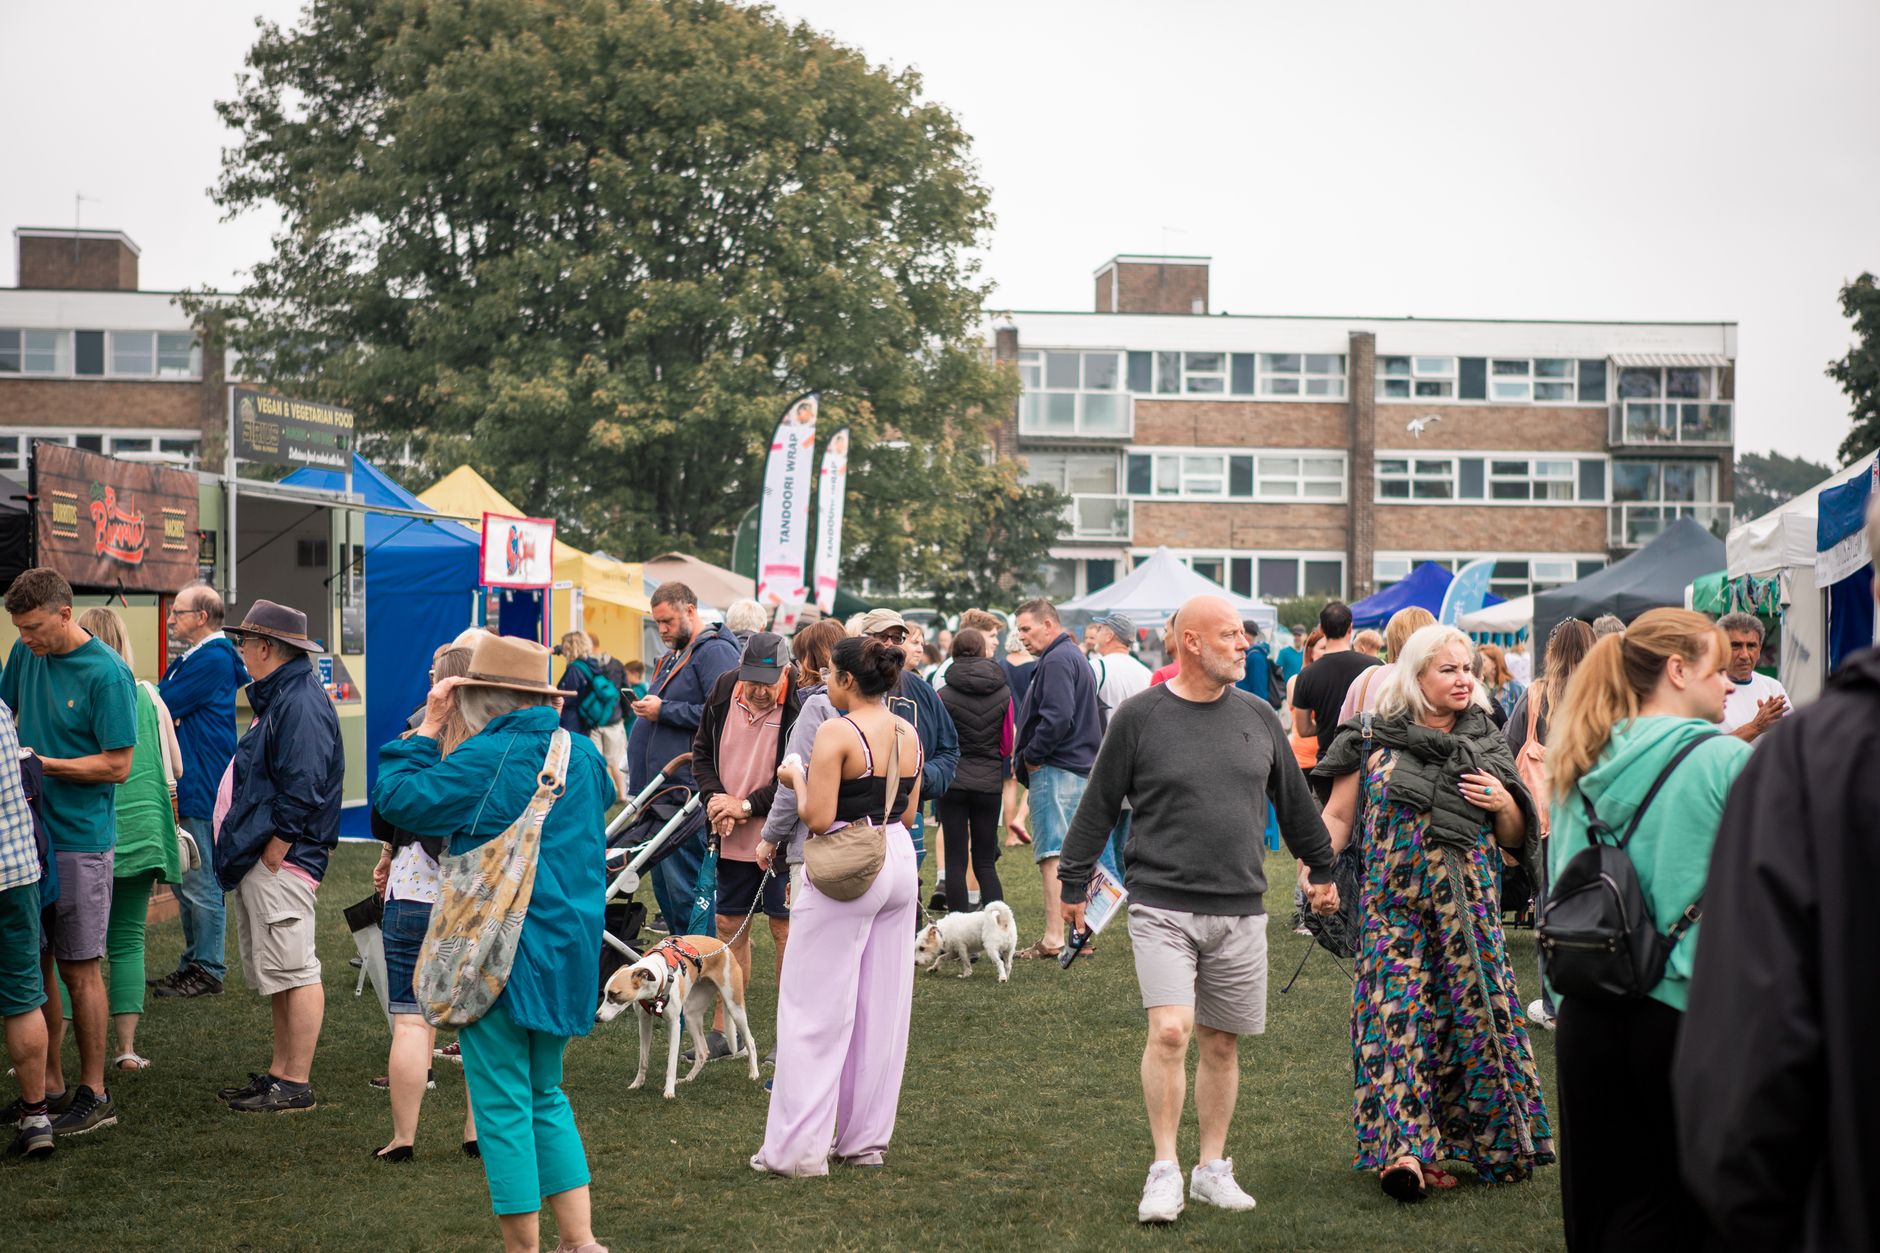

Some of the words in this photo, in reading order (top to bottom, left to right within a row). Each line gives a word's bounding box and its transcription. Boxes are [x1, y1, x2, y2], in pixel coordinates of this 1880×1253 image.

[257, 396, 282, 416] VEGAN
[283, 401, 290, 417] &
[290, 402, 334, 425] VEGETARIAN
[334, 411, 354, 429] FOOD
[786, 434, 798, 472] WRAP
[52, 502, 78, 525] BURRITOS
[780, 476, 794, 544] TANDOORI
[164, 518, 185, 538] NACHOS
